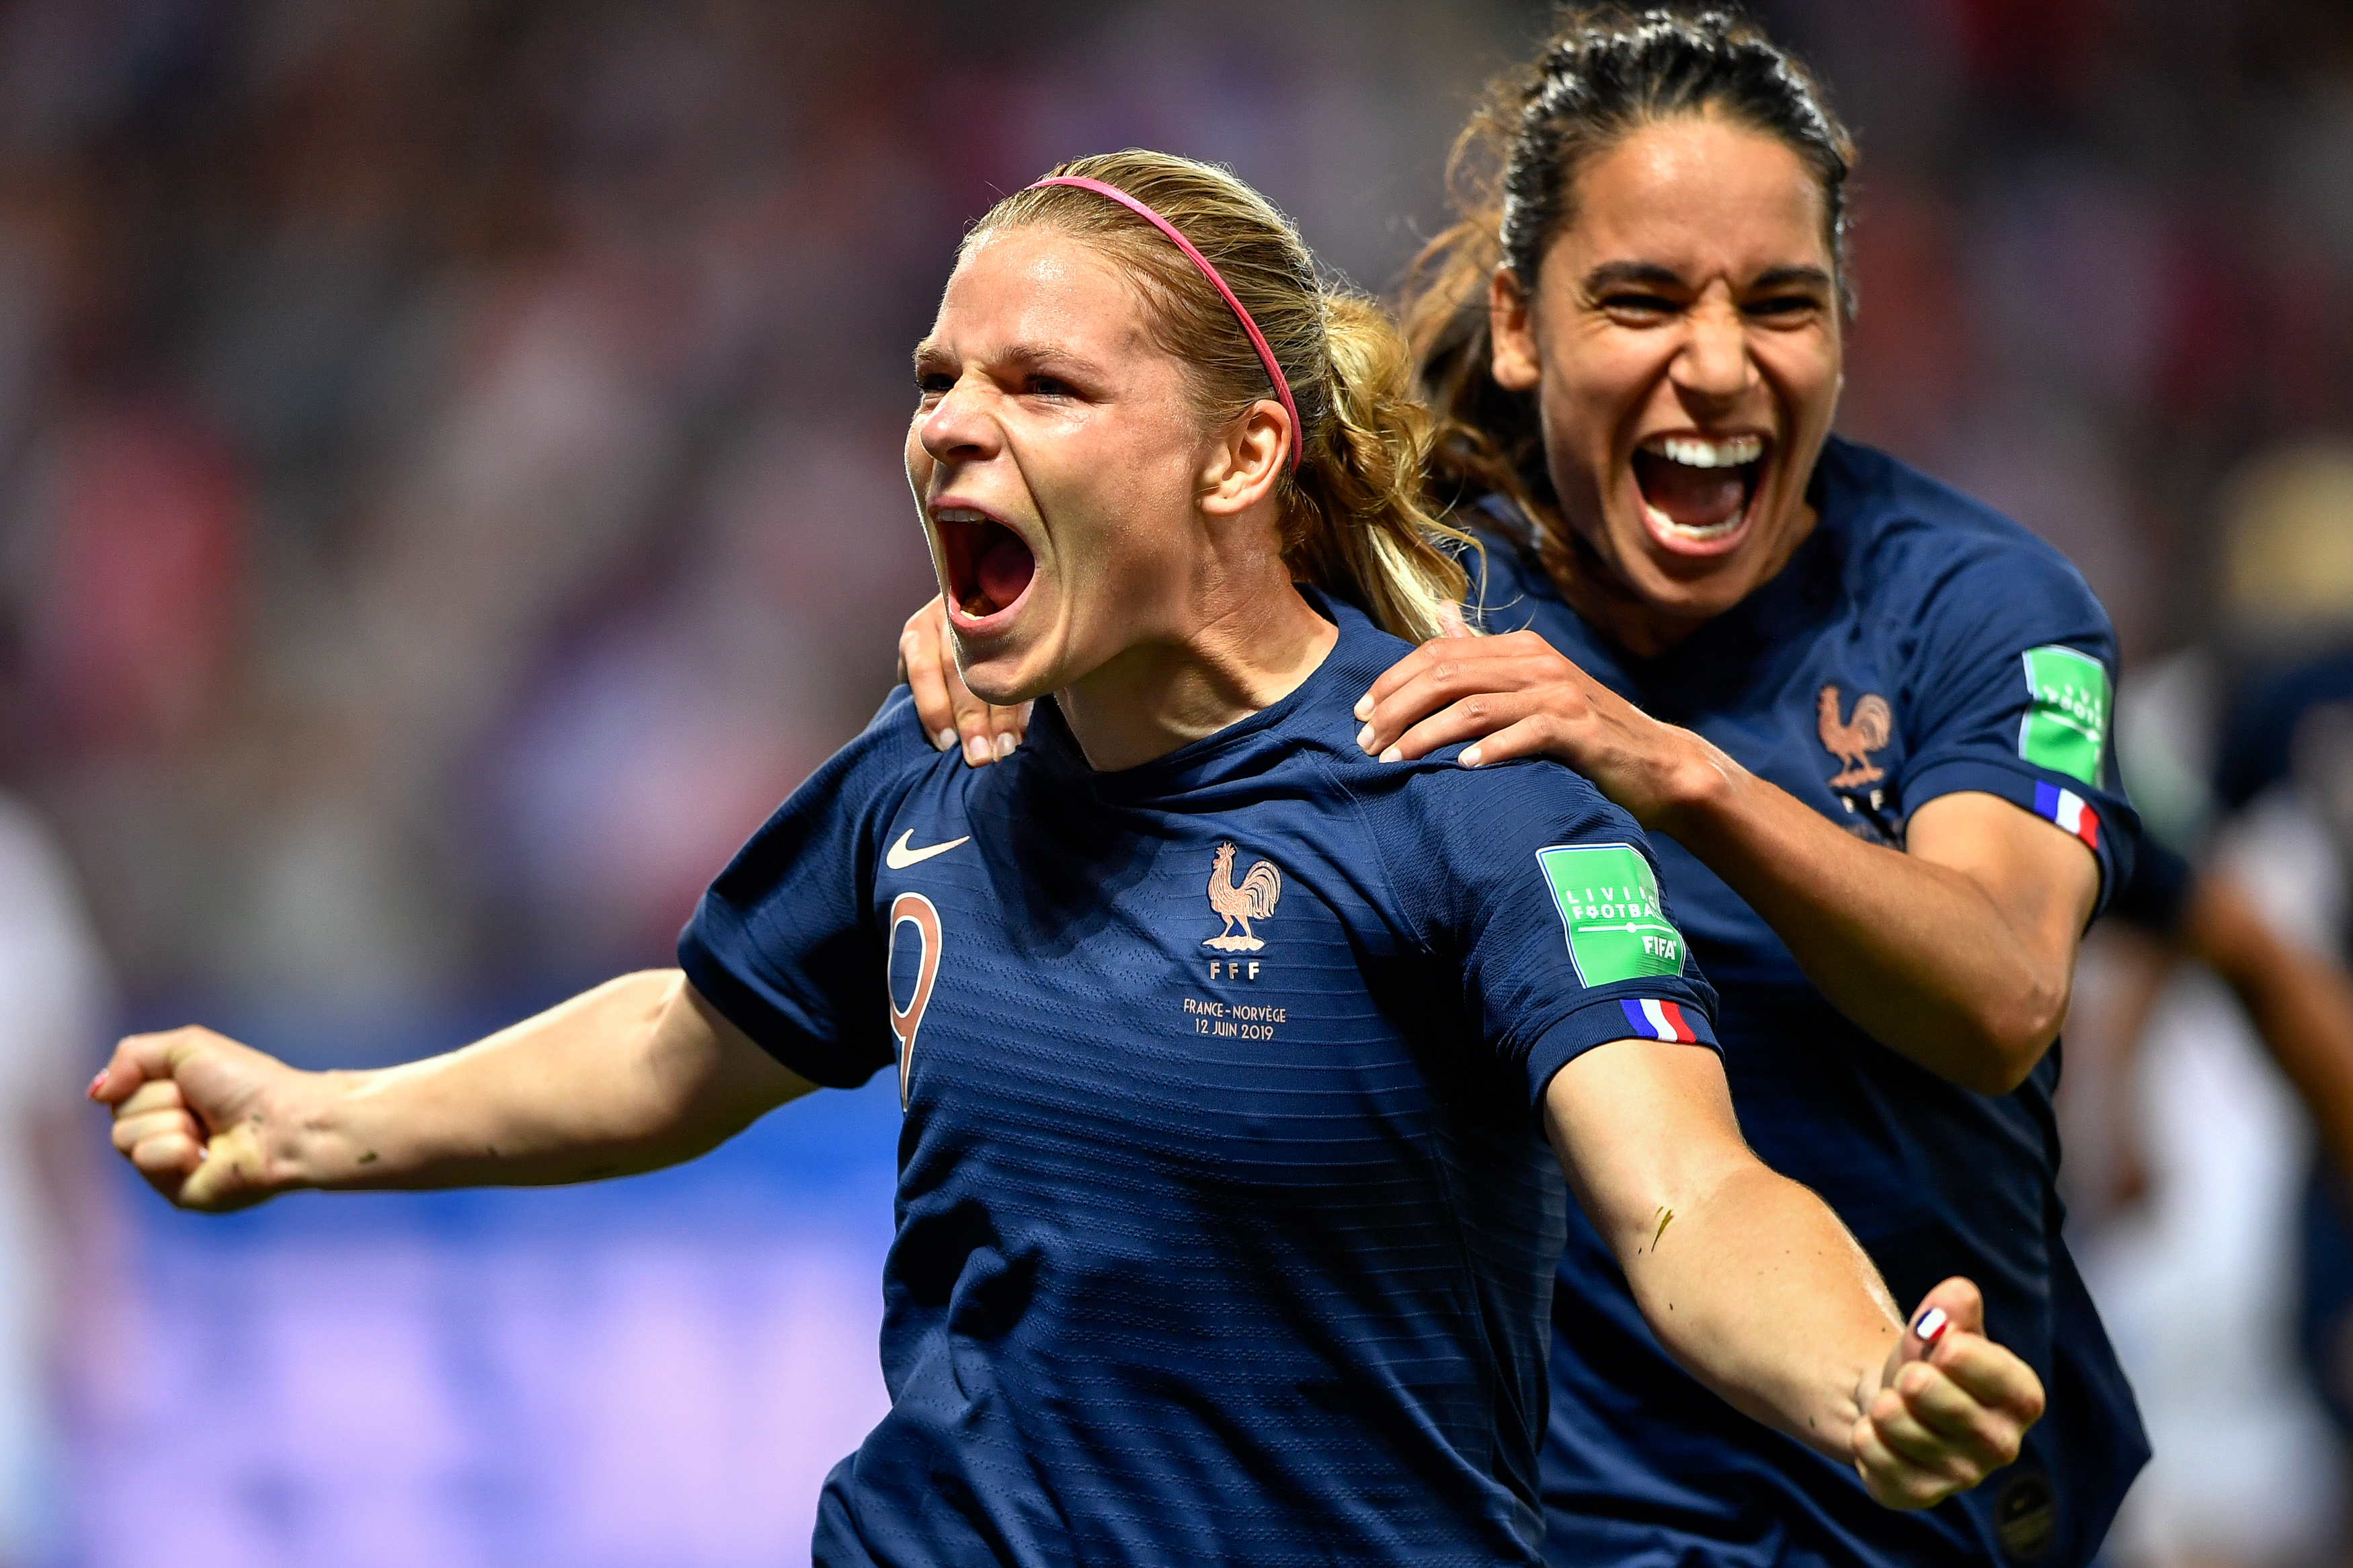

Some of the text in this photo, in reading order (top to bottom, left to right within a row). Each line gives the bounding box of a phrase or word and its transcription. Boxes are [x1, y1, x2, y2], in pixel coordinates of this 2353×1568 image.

[1641, 936, 1676, 960] FIFA
[887, 891, 943, 1112] 9
[1195, 1018, 1274, 1040] 12 JUIN 2019
